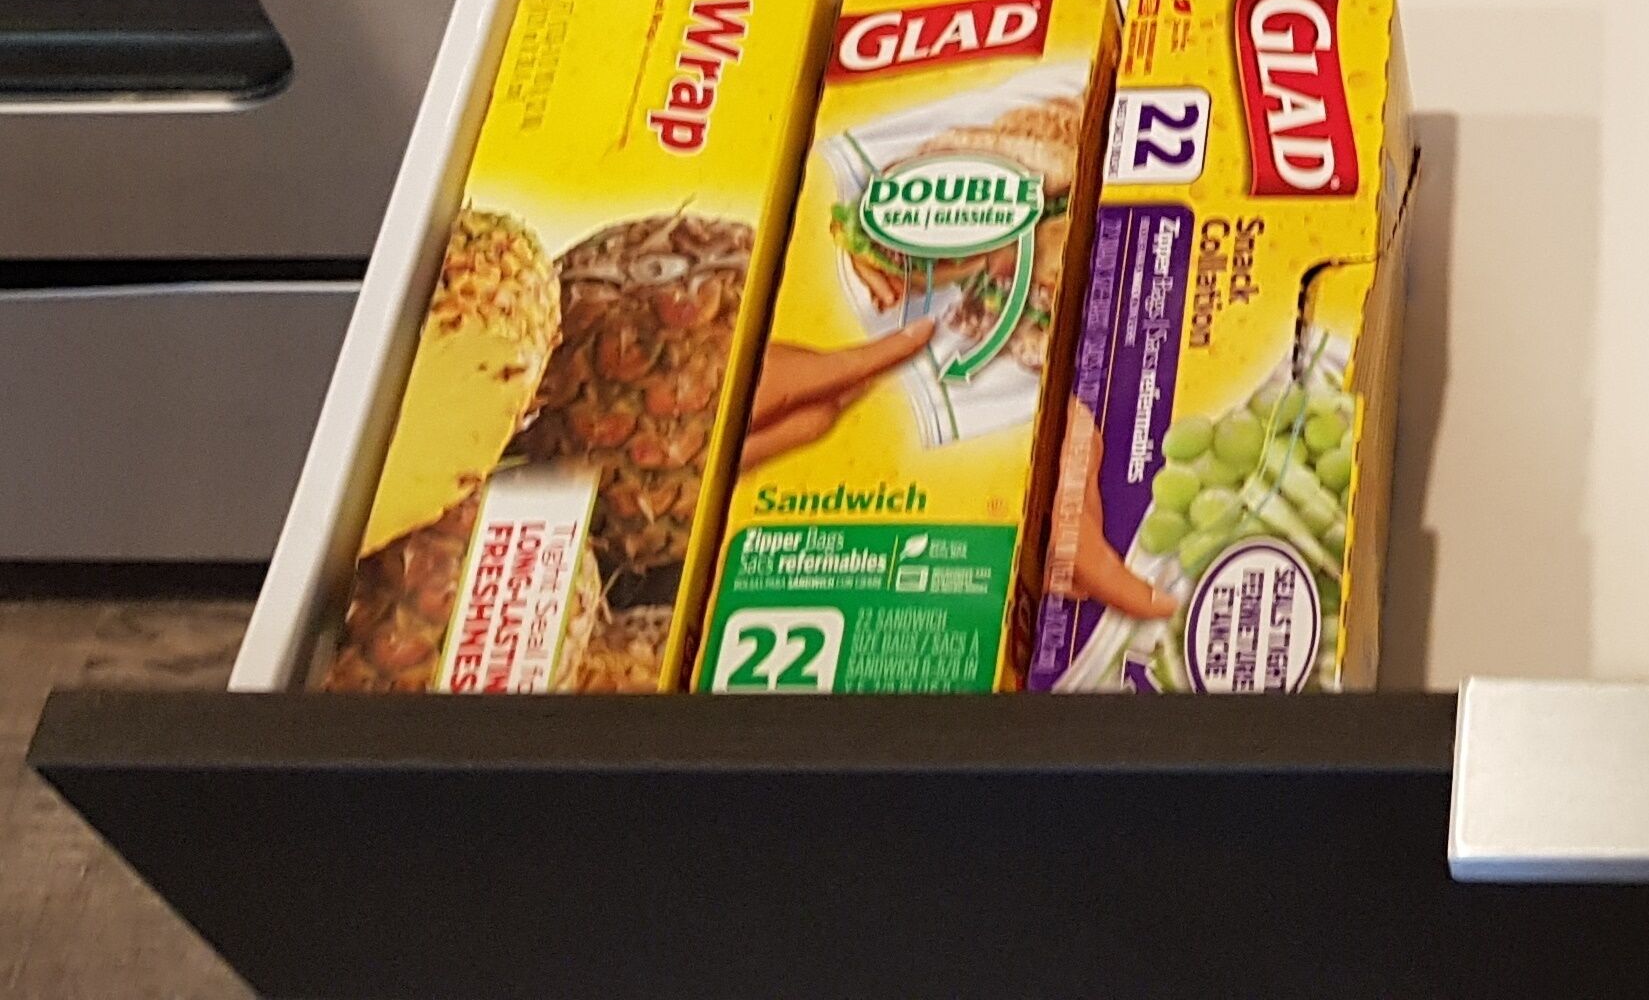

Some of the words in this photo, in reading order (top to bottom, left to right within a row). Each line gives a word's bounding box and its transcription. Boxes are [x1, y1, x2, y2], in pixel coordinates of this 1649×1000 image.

[839, 1, 1040, 71] GLAD
[1133, 101, 1200, 171] 22
[868, 175, 1042, 205] DOUBLE
[883, 208, 920, 225] SEAL
[1152, 216, 1181, 276] Zipper
[1229, 216, 1265, 306] Snack
[1189, 218, 1231, 347] Collation
[1127, 369, 1161, 484] refermables
[754, 481, 928, 516] Sandwich
[743, 526, 803, 556] Zipper
[805, 525, 845, 555] Bags
[777, 547, 888, 578] refermables
[450, 519, 515, 694] FRESHNES
[484, 519, 547, 694] LONG-LASTIN
[727, 626, 826, 687] 22
